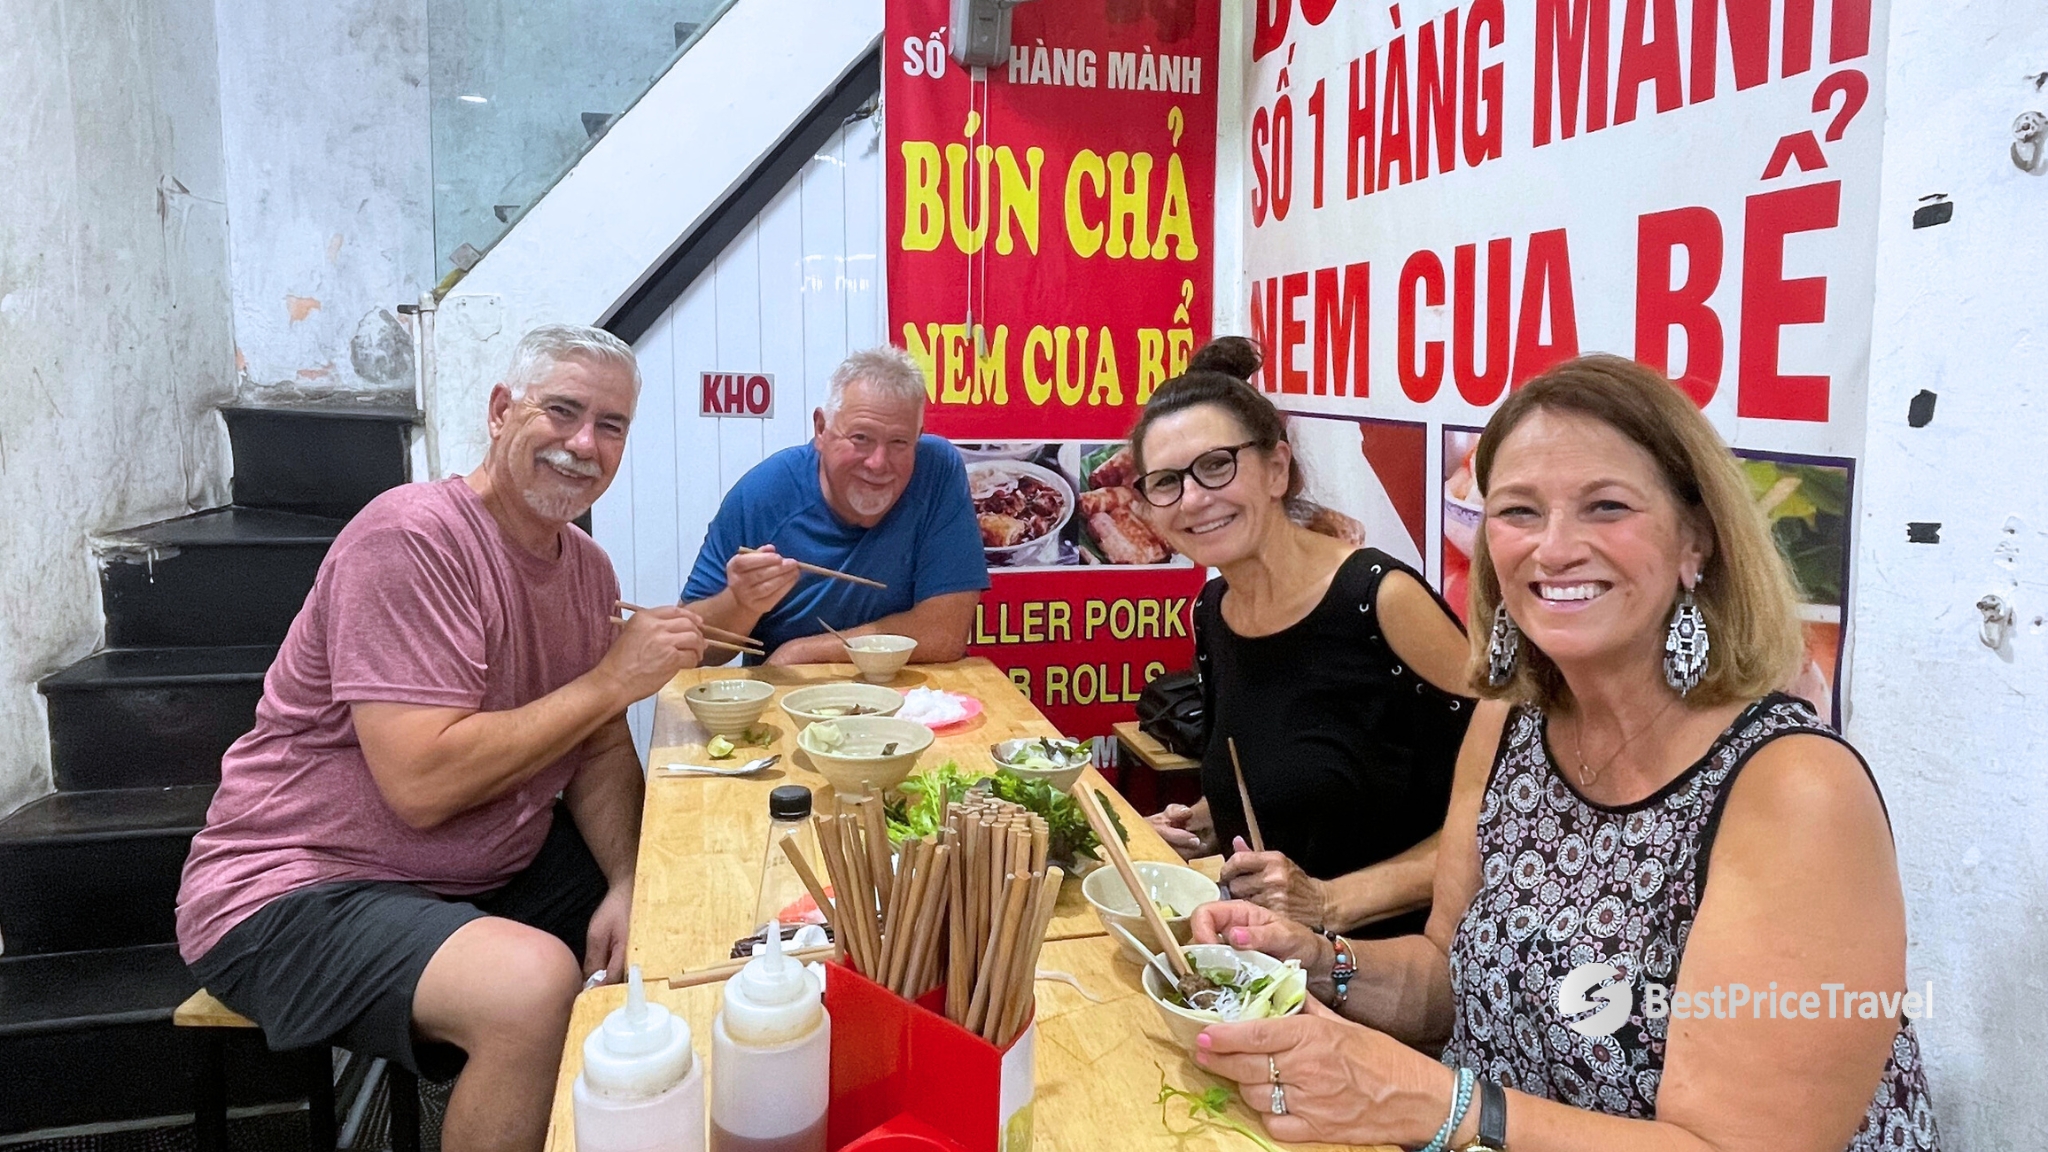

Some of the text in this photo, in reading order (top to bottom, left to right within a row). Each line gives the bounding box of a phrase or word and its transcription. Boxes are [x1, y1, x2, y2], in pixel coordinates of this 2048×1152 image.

[903, 27, 1202, 95] SỐ HÀNG MÀNH
[1252, 42, 1296, 228] SỐ
[1308, 78, 1325, 209] 1
[1347, 0, 1504, 201] HÀNG
[901, 105, 1198, 261] BÚN CHẢ
[1250, 69, 1870, 423] NEM CUA BỂ
[703, 374, 770, 414] KHO
[904, 322, 1008, 404] NEM
[1022, 324, 1123, 405] CUA
[967, 598, 1187, 644] LLER PORK
